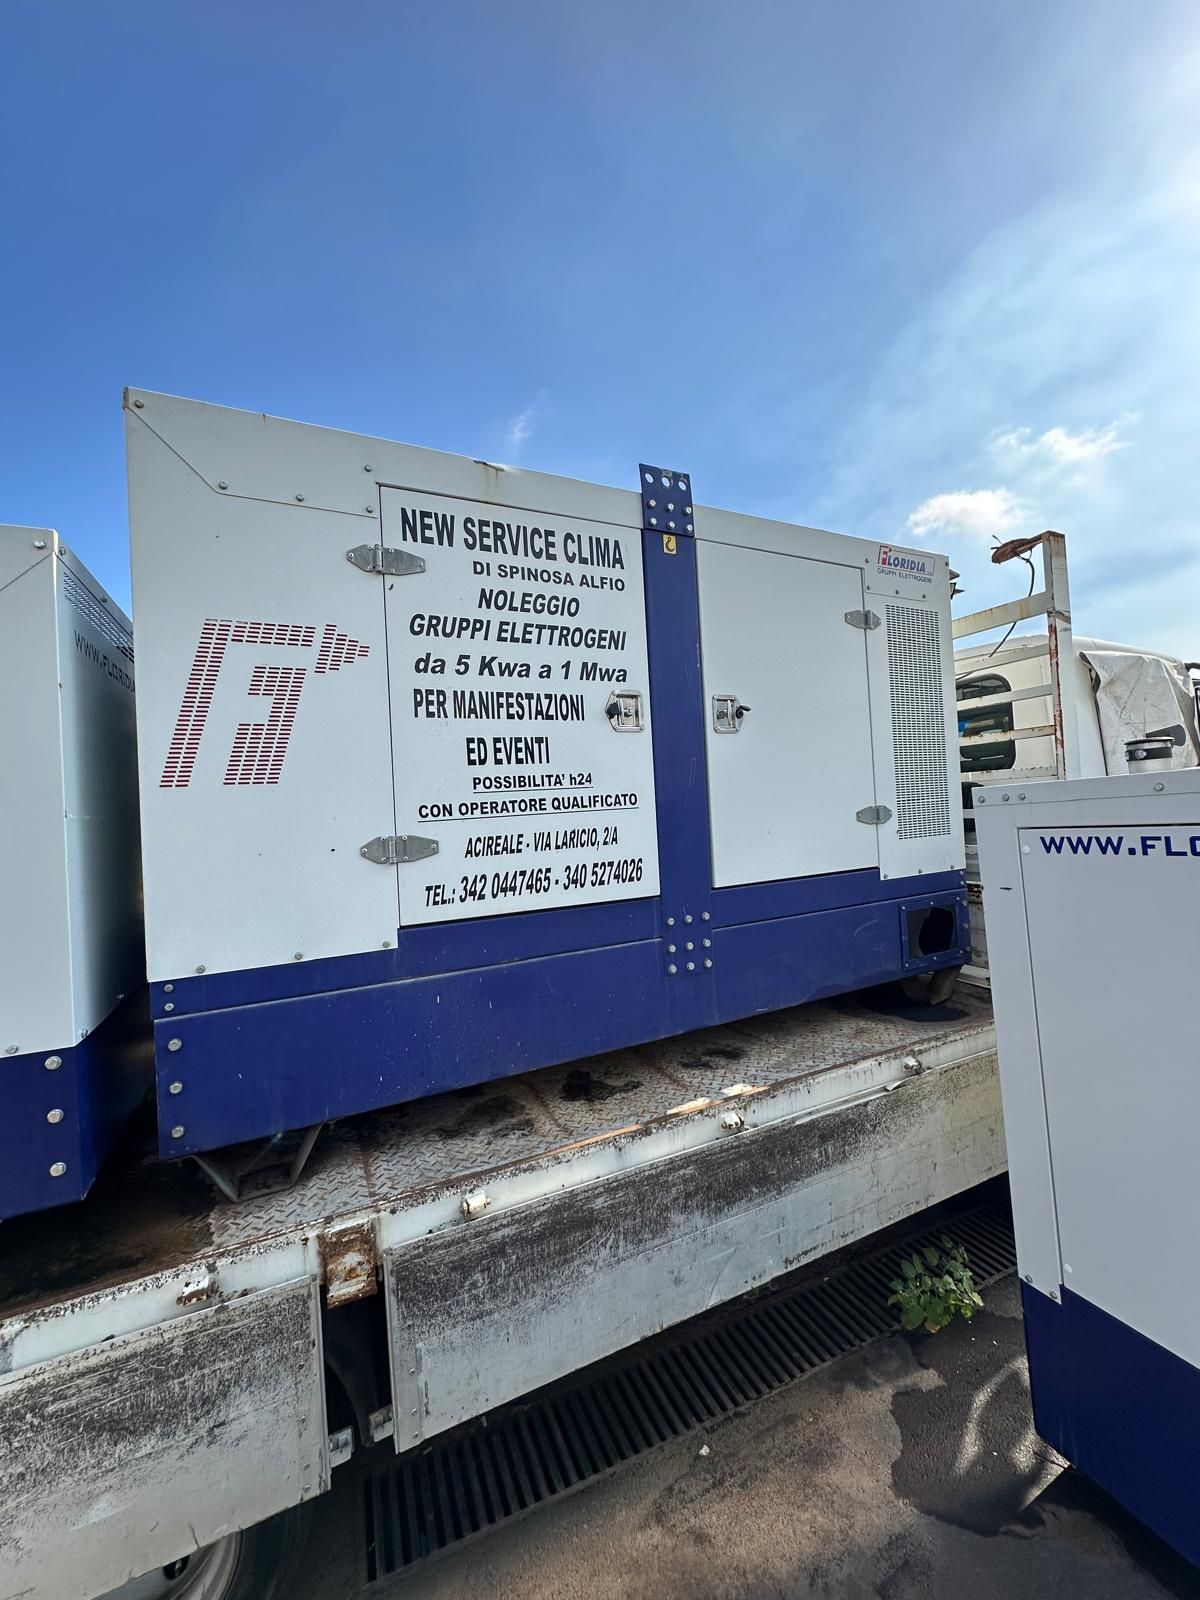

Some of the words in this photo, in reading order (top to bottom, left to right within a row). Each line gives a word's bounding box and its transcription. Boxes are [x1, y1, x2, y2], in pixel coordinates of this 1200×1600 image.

[401, 508, 454, 547] NEW
[463, 517, 557, 560] SERVICE
[564, 533, 624, 569] CLIMA
[473, 561, 491, 576] DI
[498, 564, 574, 585] SPINOSA
[579, 575, 625, 591] ALFIO
[877, 568, 897, 577] GRUPPI
[899, 572, 932, 583] ELETTROGENI
[478, 588, 579, 617] NOLEGGIO
[409, 614, 491, 641] GRUPPI
[497, 621, 626, 650] ELETTROGENI
[415, 653, 445, 674] da
[455, 655, 470, 675] 5
[478, 656, 531, 678] Kwa
[539, 664, 552, 679] a
[560, 660, 572, 679] 1
[579, 662, 627, 682] Mwa
[414, 689, 448, 718] PER
[453, 690, 584, 721] MANIFESTAZIONI
[466, 737, 487, 765] ED
[493, 737, 549, 764] EVENTI
[569, 773, 592, 785] h24
[419, 804, 452, 818] CON
[459, 797, 547, 815] OPERATORE
[552, 793, 637, 810] QUALIFICATO
[465, 834, 523, 858] ACIREALE
[534, 832, 551, 852] VIA
[555, 828, 600, 850] LARICIO,
[603, 827, 618, 845] 2/A
[426, 884, 455, 906] TEL.:
[460, 875, 487, 902] 342
[492, 868, 551, 898] 0447465
[564, 864, 587, 889] 340
[591, 858, 642, 886] 5274026
